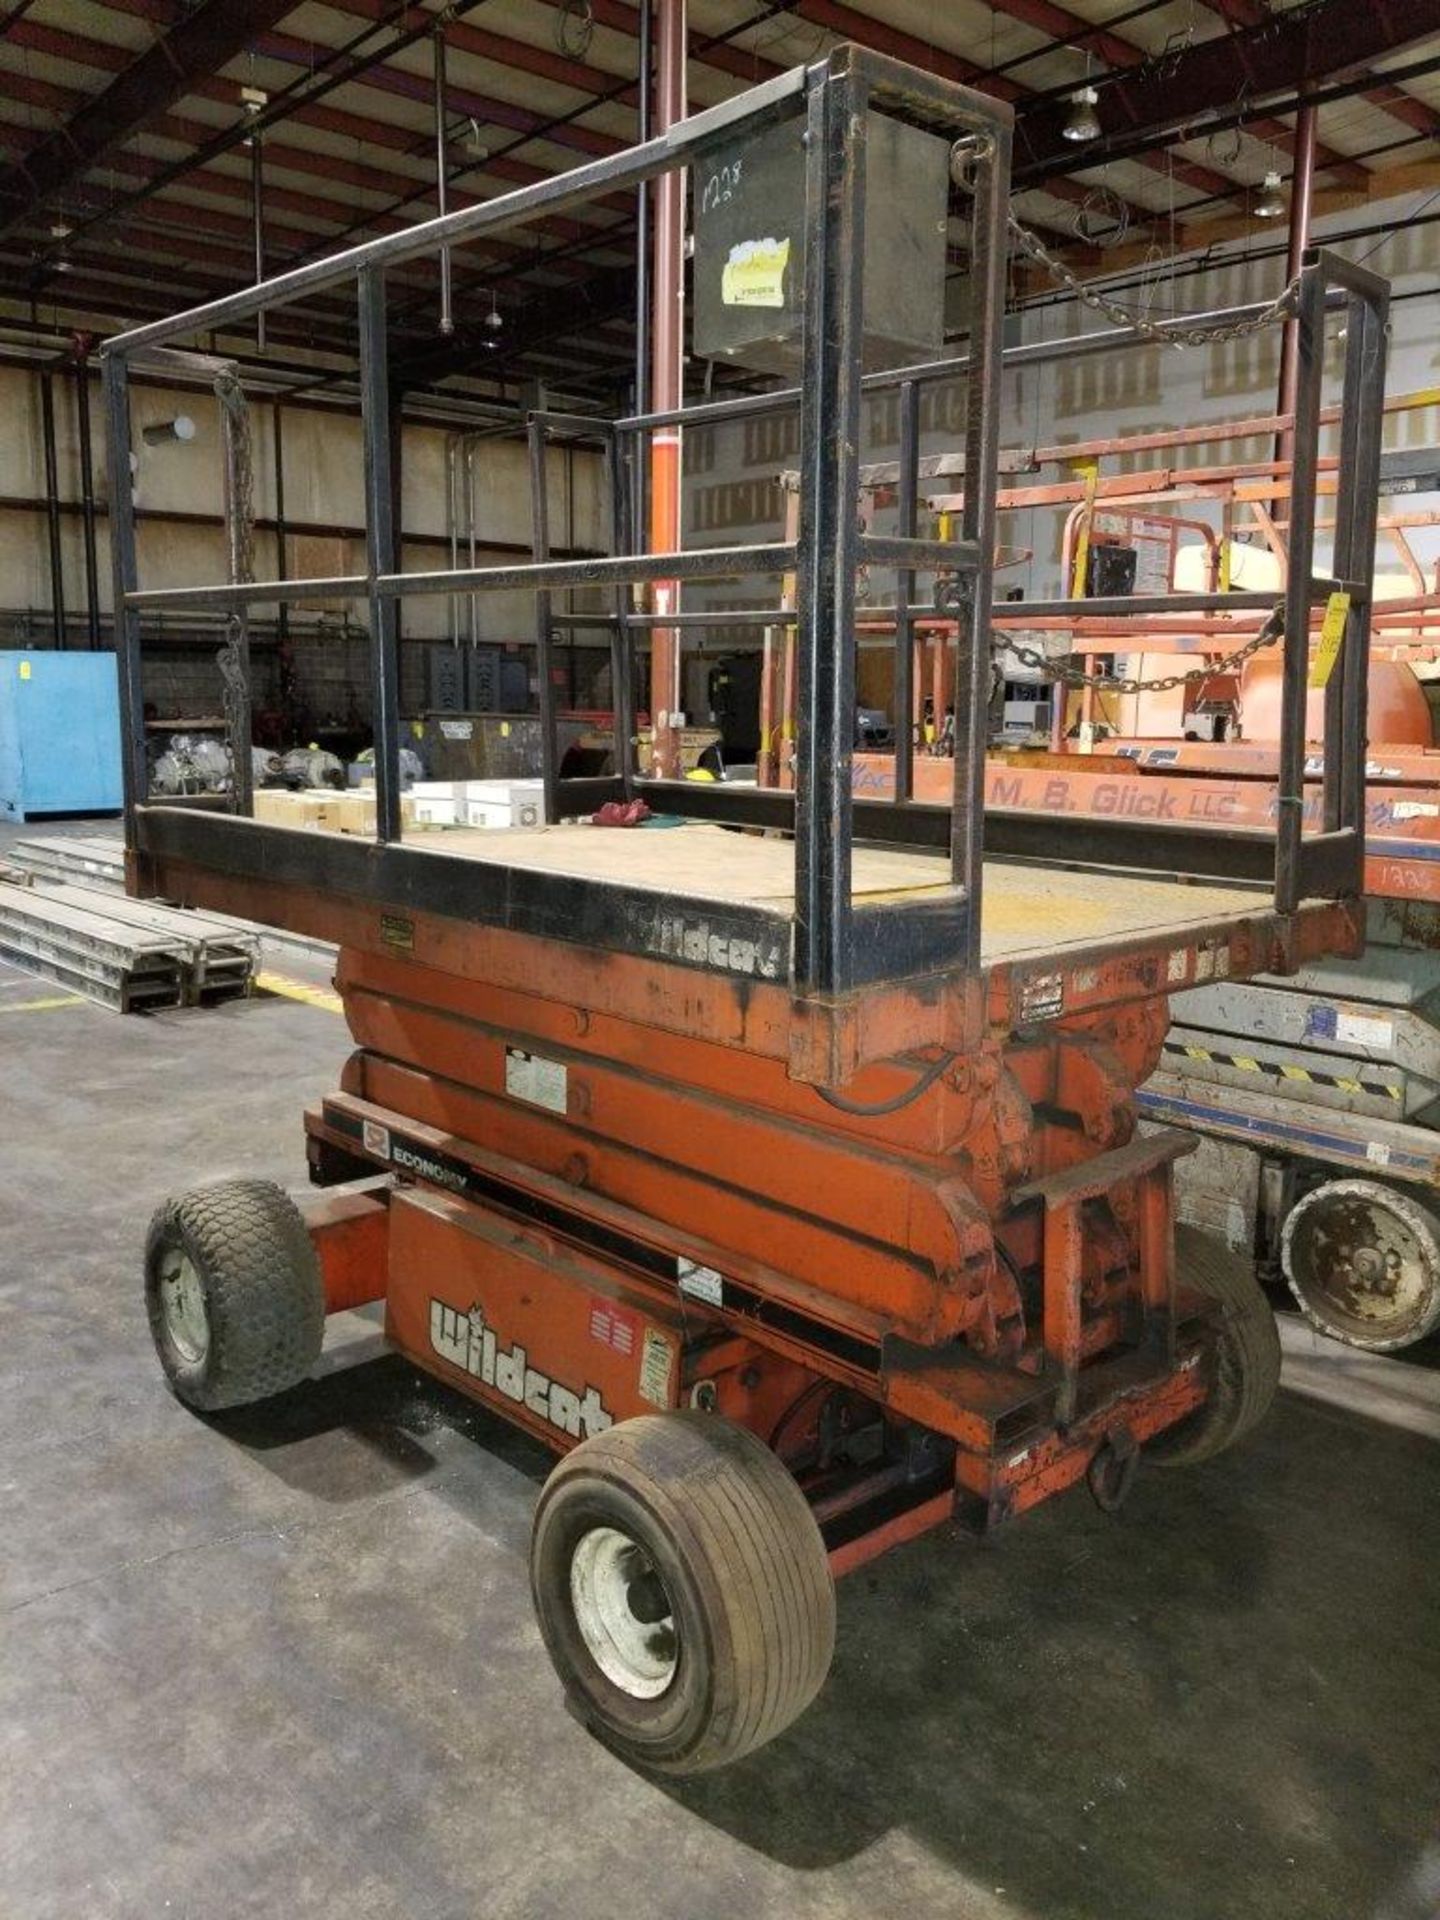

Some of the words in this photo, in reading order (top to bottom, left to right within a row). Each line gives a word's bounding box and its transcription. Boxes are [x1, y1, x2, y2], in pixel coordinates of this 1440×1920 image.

[991, 776, 1031, 805] M.
[1044, 779, 1076, 810] B.
[1090, 783, 1179, 819] Glick
[430, 1297, 615, 1442] Wildcat
